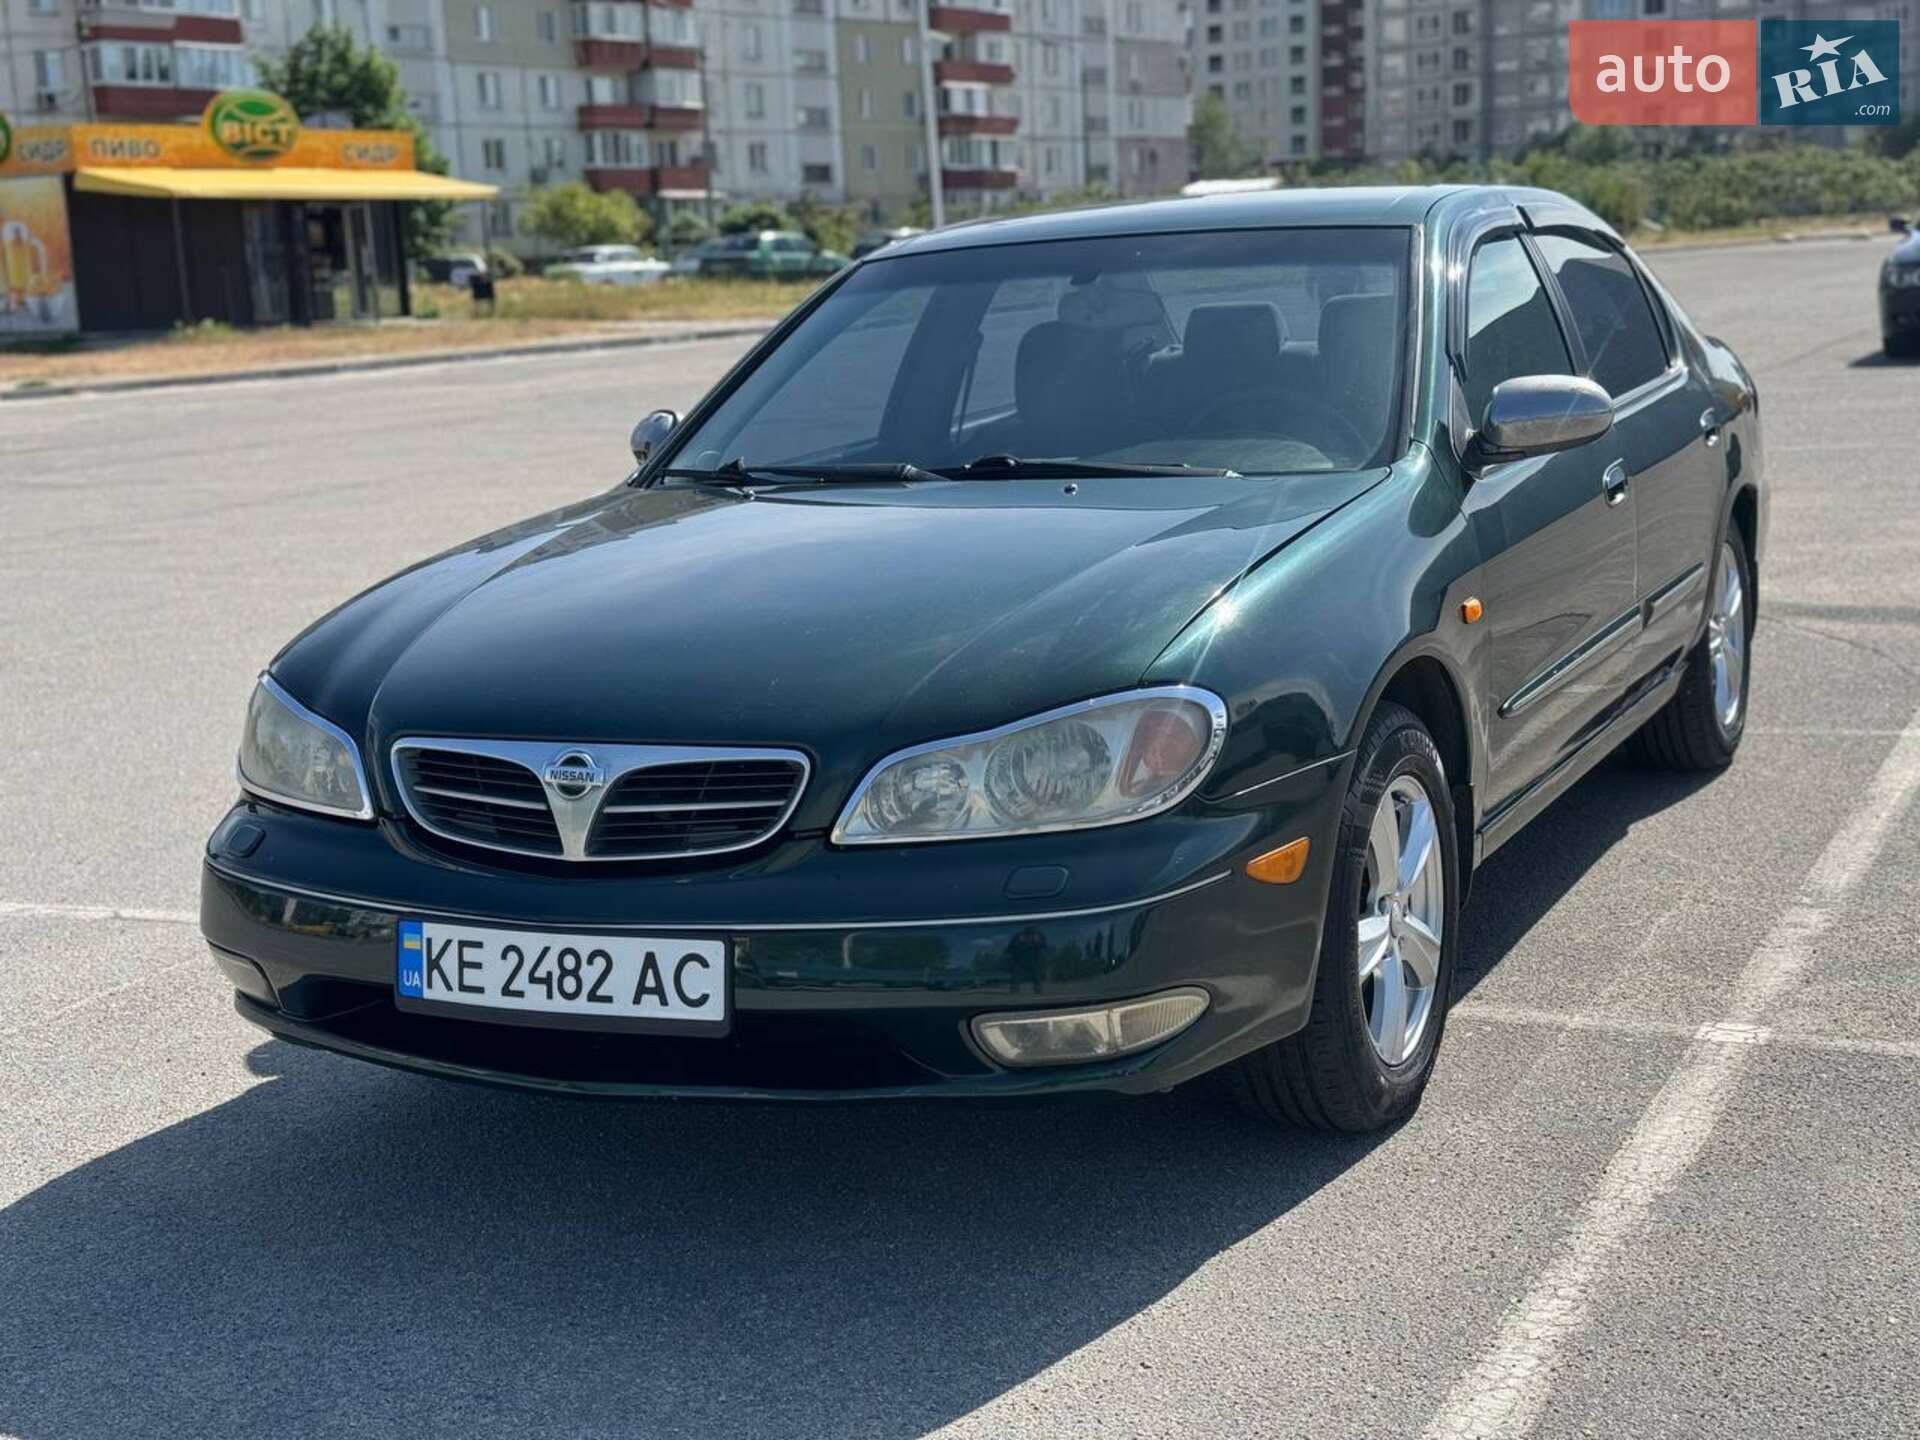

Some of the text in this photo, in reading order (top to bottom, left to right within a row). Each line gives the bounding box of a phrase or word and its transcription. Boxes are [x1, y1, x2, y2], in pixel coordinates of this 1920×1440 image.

[90, 137, 161, 159] ПИВО
[549, 769, 596, 783] NISSAN
[403, 970, 421, 988] UA
[426, 937, 710, 1009] KE 2482 AC
